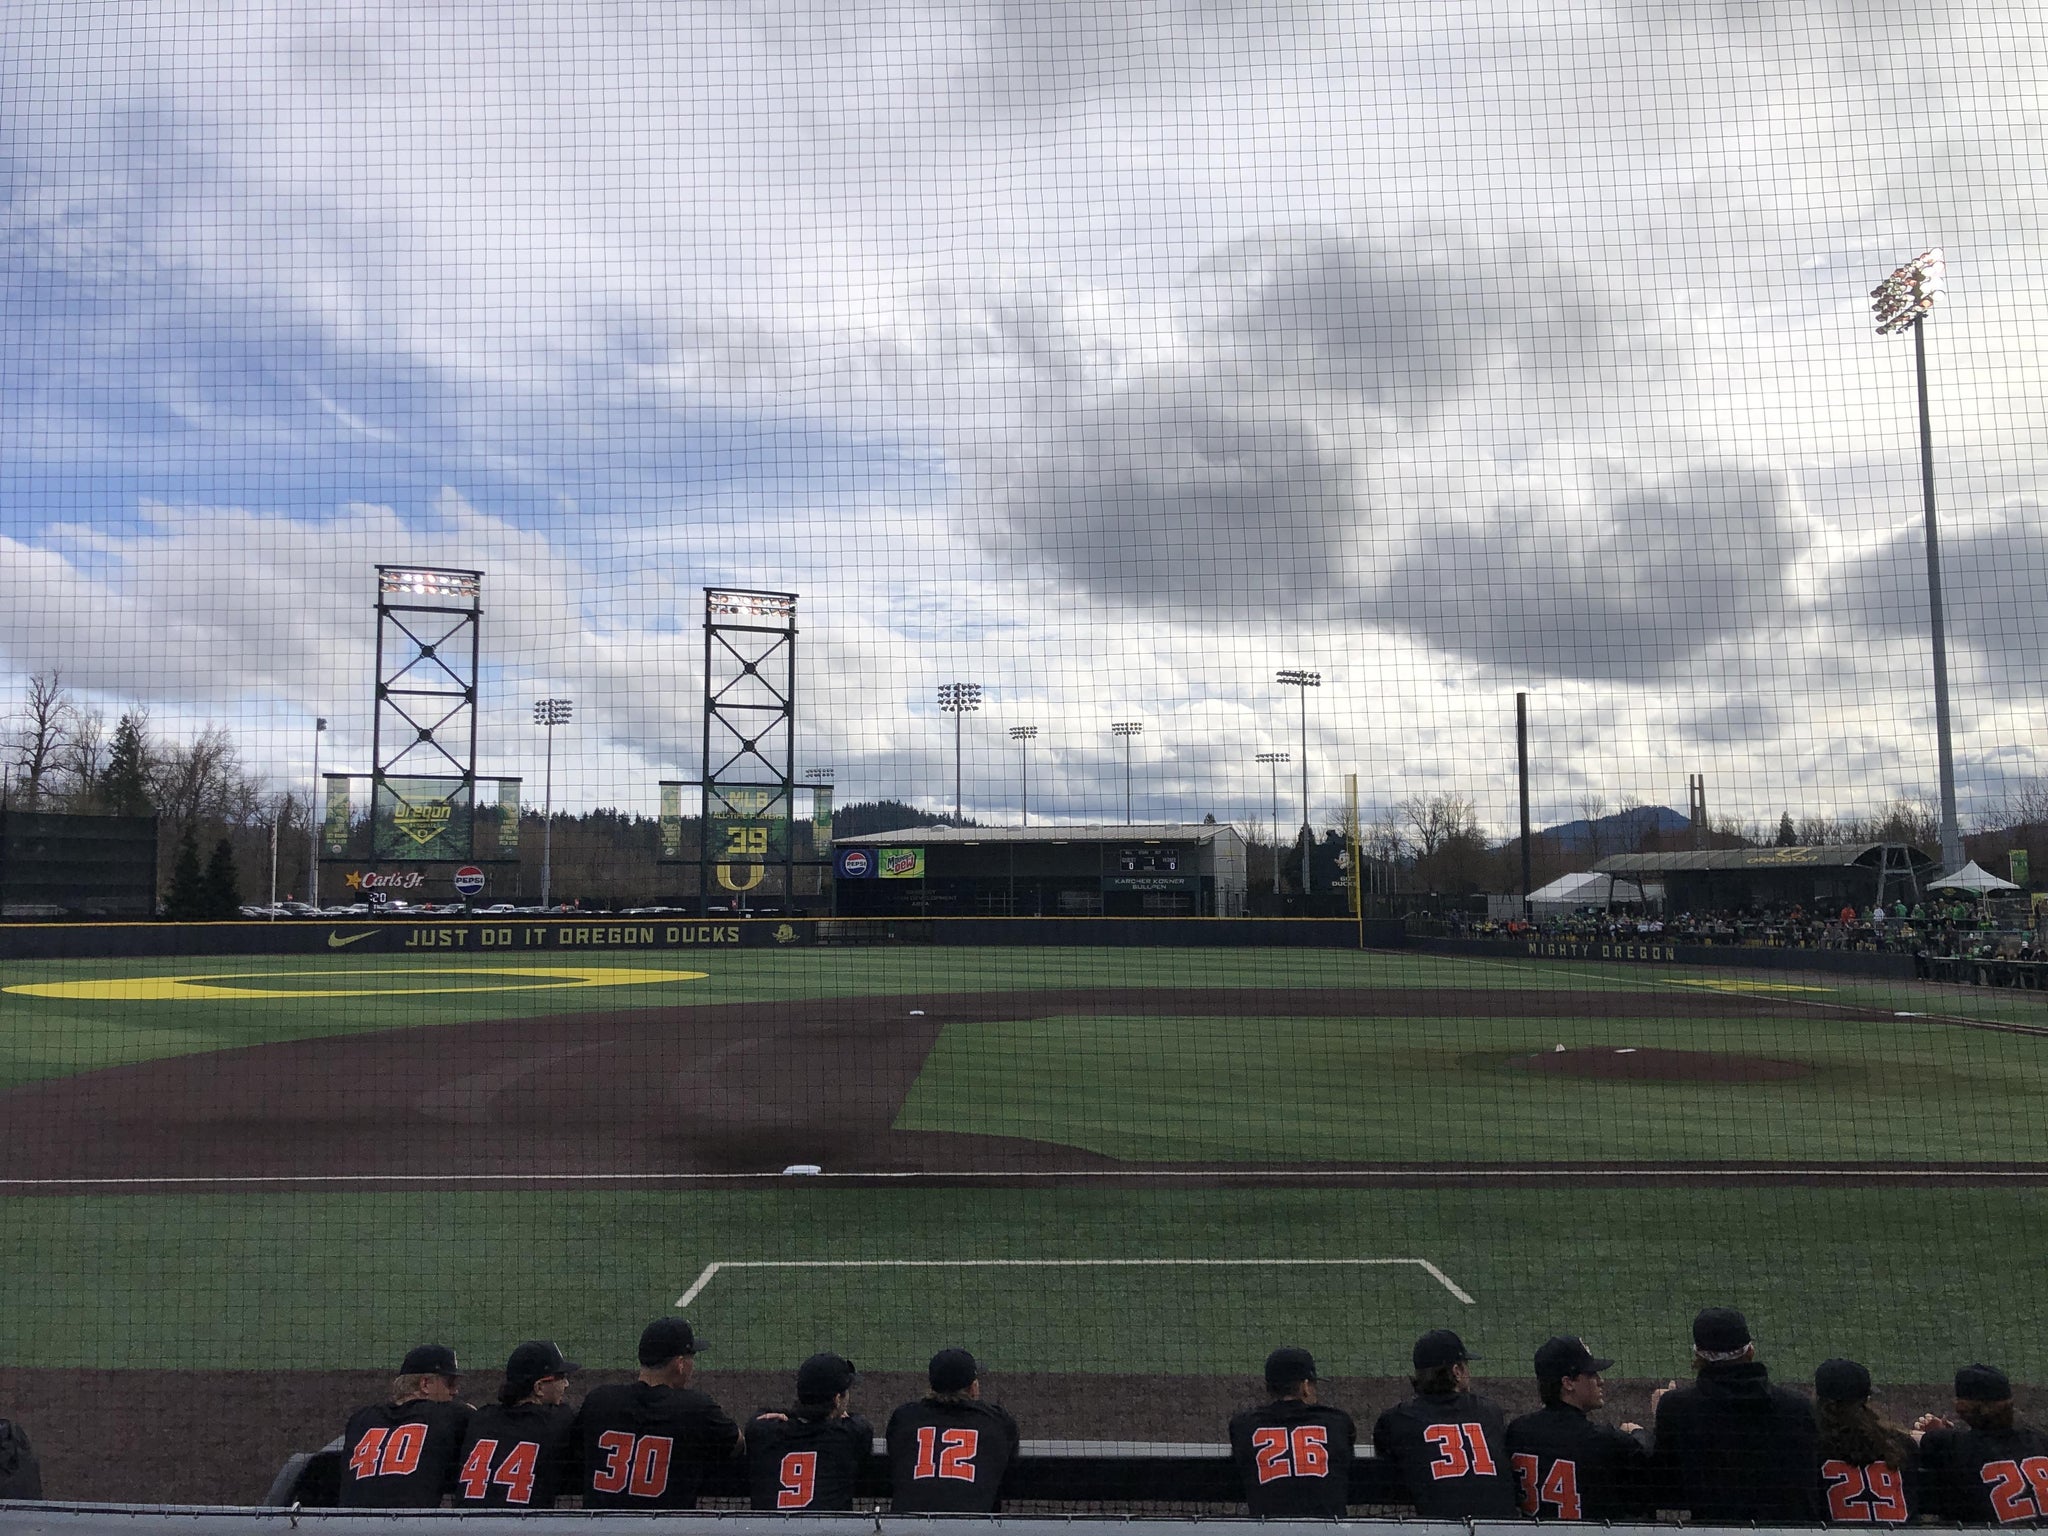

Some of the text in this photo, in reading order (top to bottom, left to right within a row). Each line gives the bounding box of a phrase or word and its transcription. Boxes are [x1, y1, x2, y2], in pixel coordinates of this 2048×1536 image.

[394, 802, 452, 821] Oregon
[729, 791, 768, 808] MLB
[727, 827, 767, 854] 39
[1128, 862, 1134, 870] 0
[1170, 862, 1176, 870] 0
[362, 872, 424, 888] Carl's Jr.
[455, 876, 484, 884] PEPSI
[405, 926, 739, 946] JUST DO IT OREGON DUCKS
[1528, 943, 1674, 960] MIGHTY OREGON
[350, 1423, 428, 1480] 40
[460, 1439, 540, 1504] 44
[594, 1430, 674, 1498] 30
[777, 1451, 817, 1508] 9
[914, 1426, 978, 1482] 12
[1253, 1425, 1329, 1484] 26
[1423, 1423, 1497, 1480] 31
[1511, 1452, 1582, 1520] 34
[1821, 1459, 1908, 1522] 29
